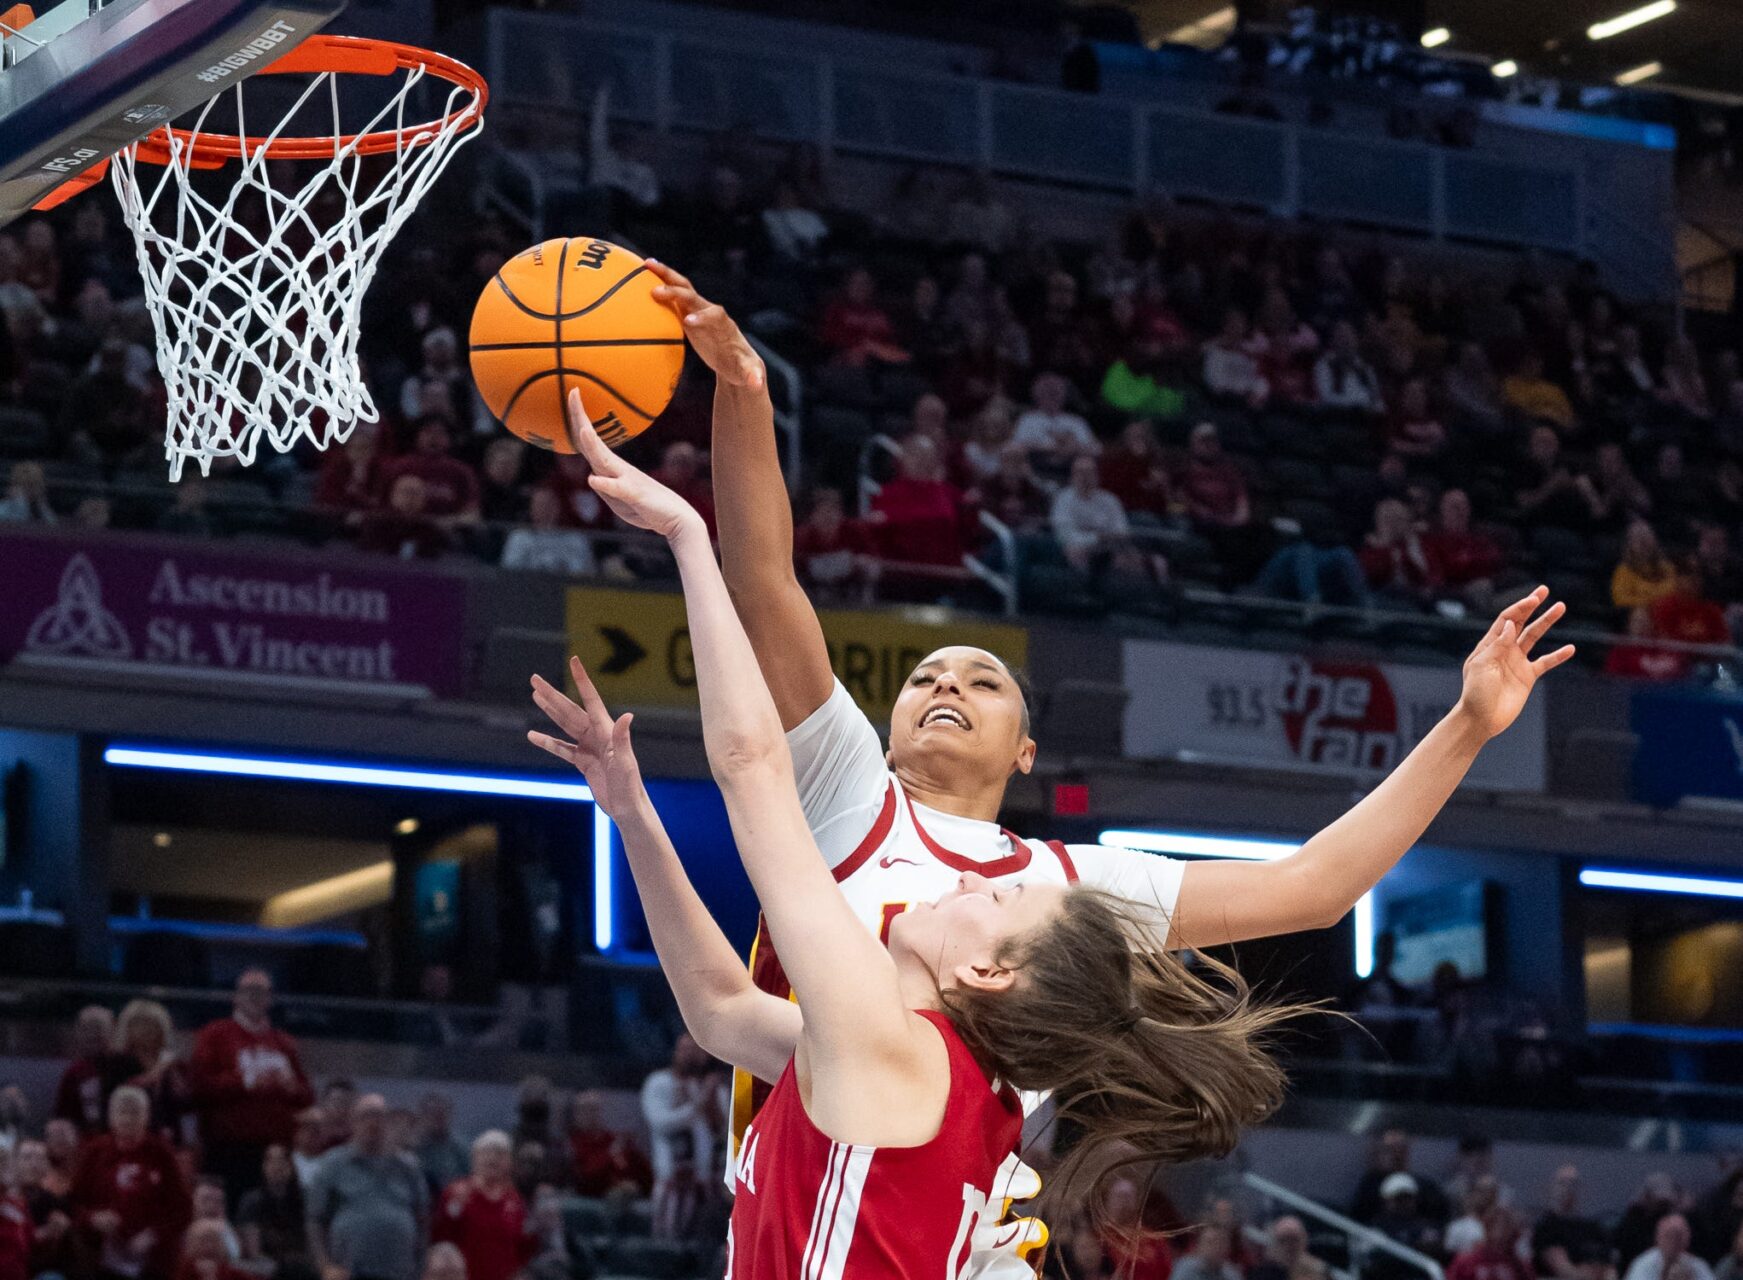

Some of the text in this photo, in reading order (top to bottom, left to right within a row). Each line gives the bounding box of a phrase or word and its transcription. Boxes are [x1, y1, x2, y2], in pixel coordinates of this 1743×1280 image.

[197, 20, 296, 84] #B1GWBBT
[150, 559, 389, 622] Ascension
[147, 616, 395, 679] St. Vincent
[1276, 656, 1372, 718] the
[1299, 718, 1397, 770] fan
